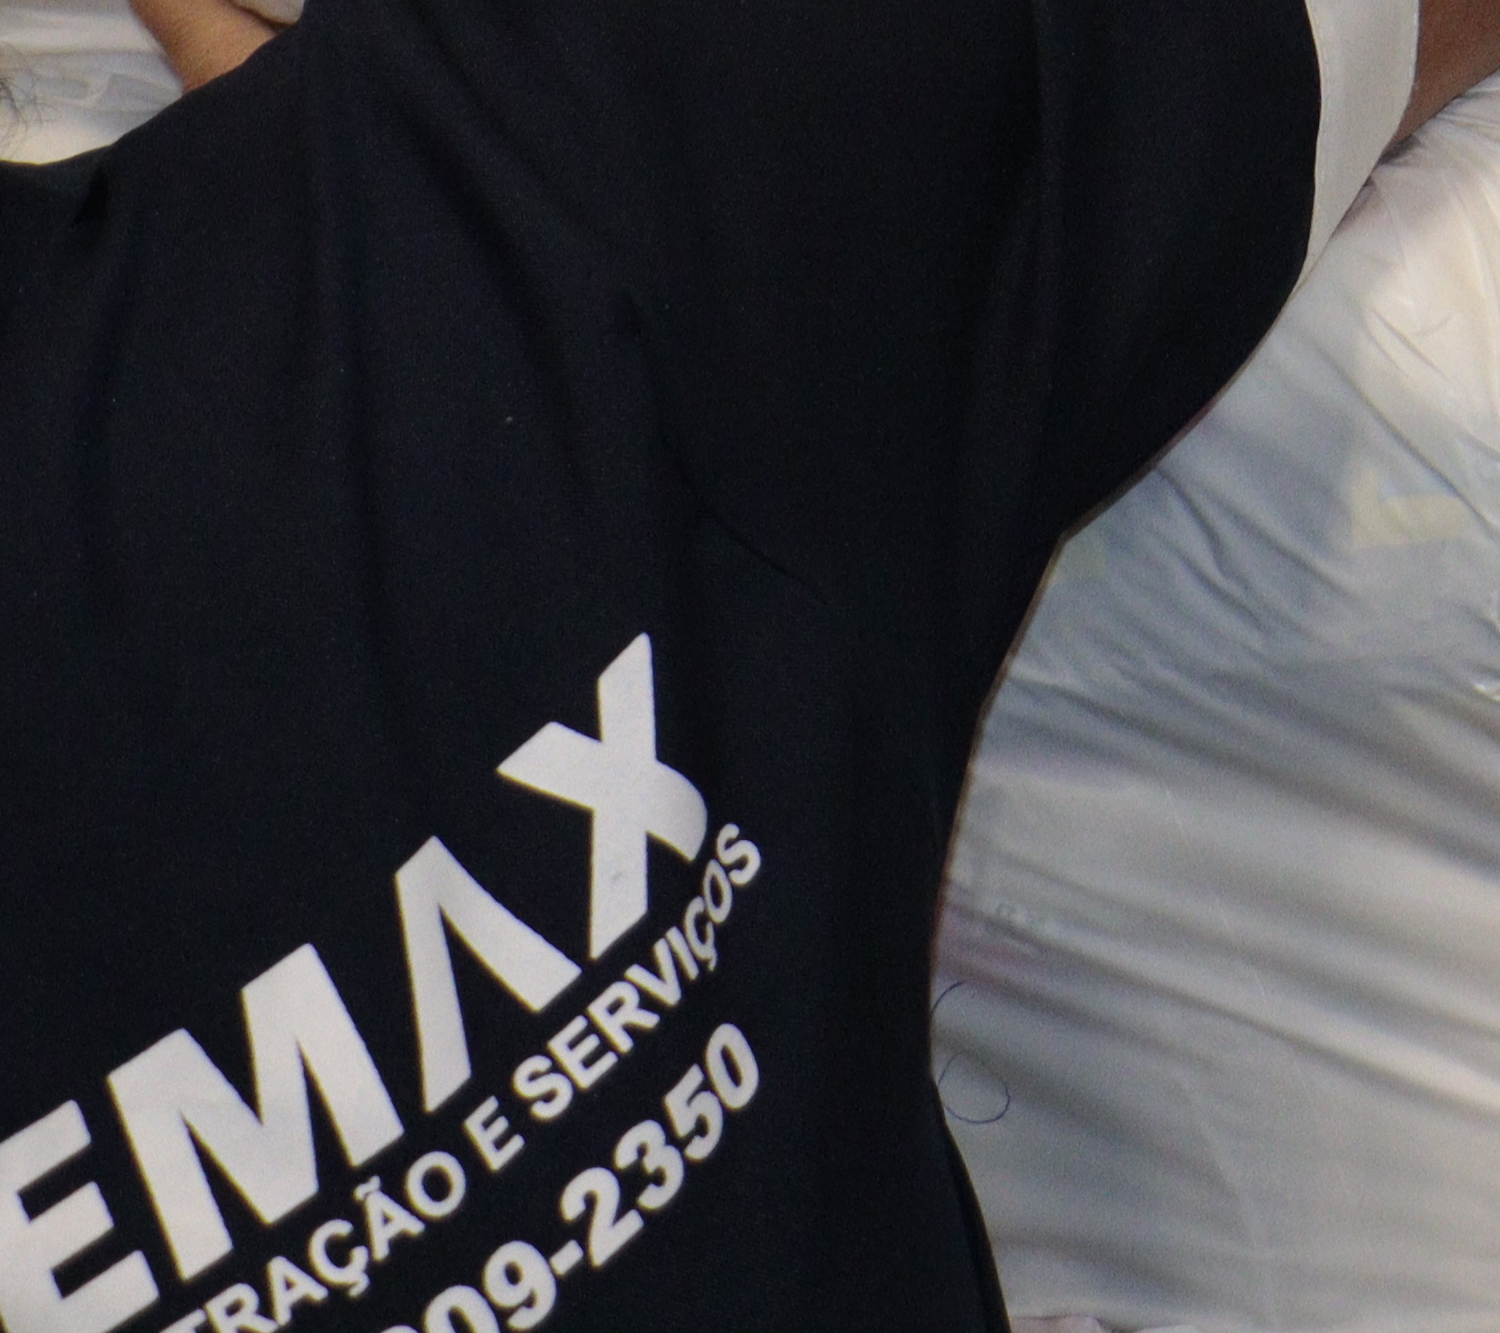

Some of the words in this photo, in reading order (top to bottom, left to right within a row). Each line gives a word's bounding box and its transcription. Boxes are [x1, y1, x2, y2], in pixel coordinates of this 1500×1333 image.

[463, 1095, 525, 1171] E
[512, 823, 761, 1121] SERVIÇOS
[380, 1022, 760, 1333] 09-2350
